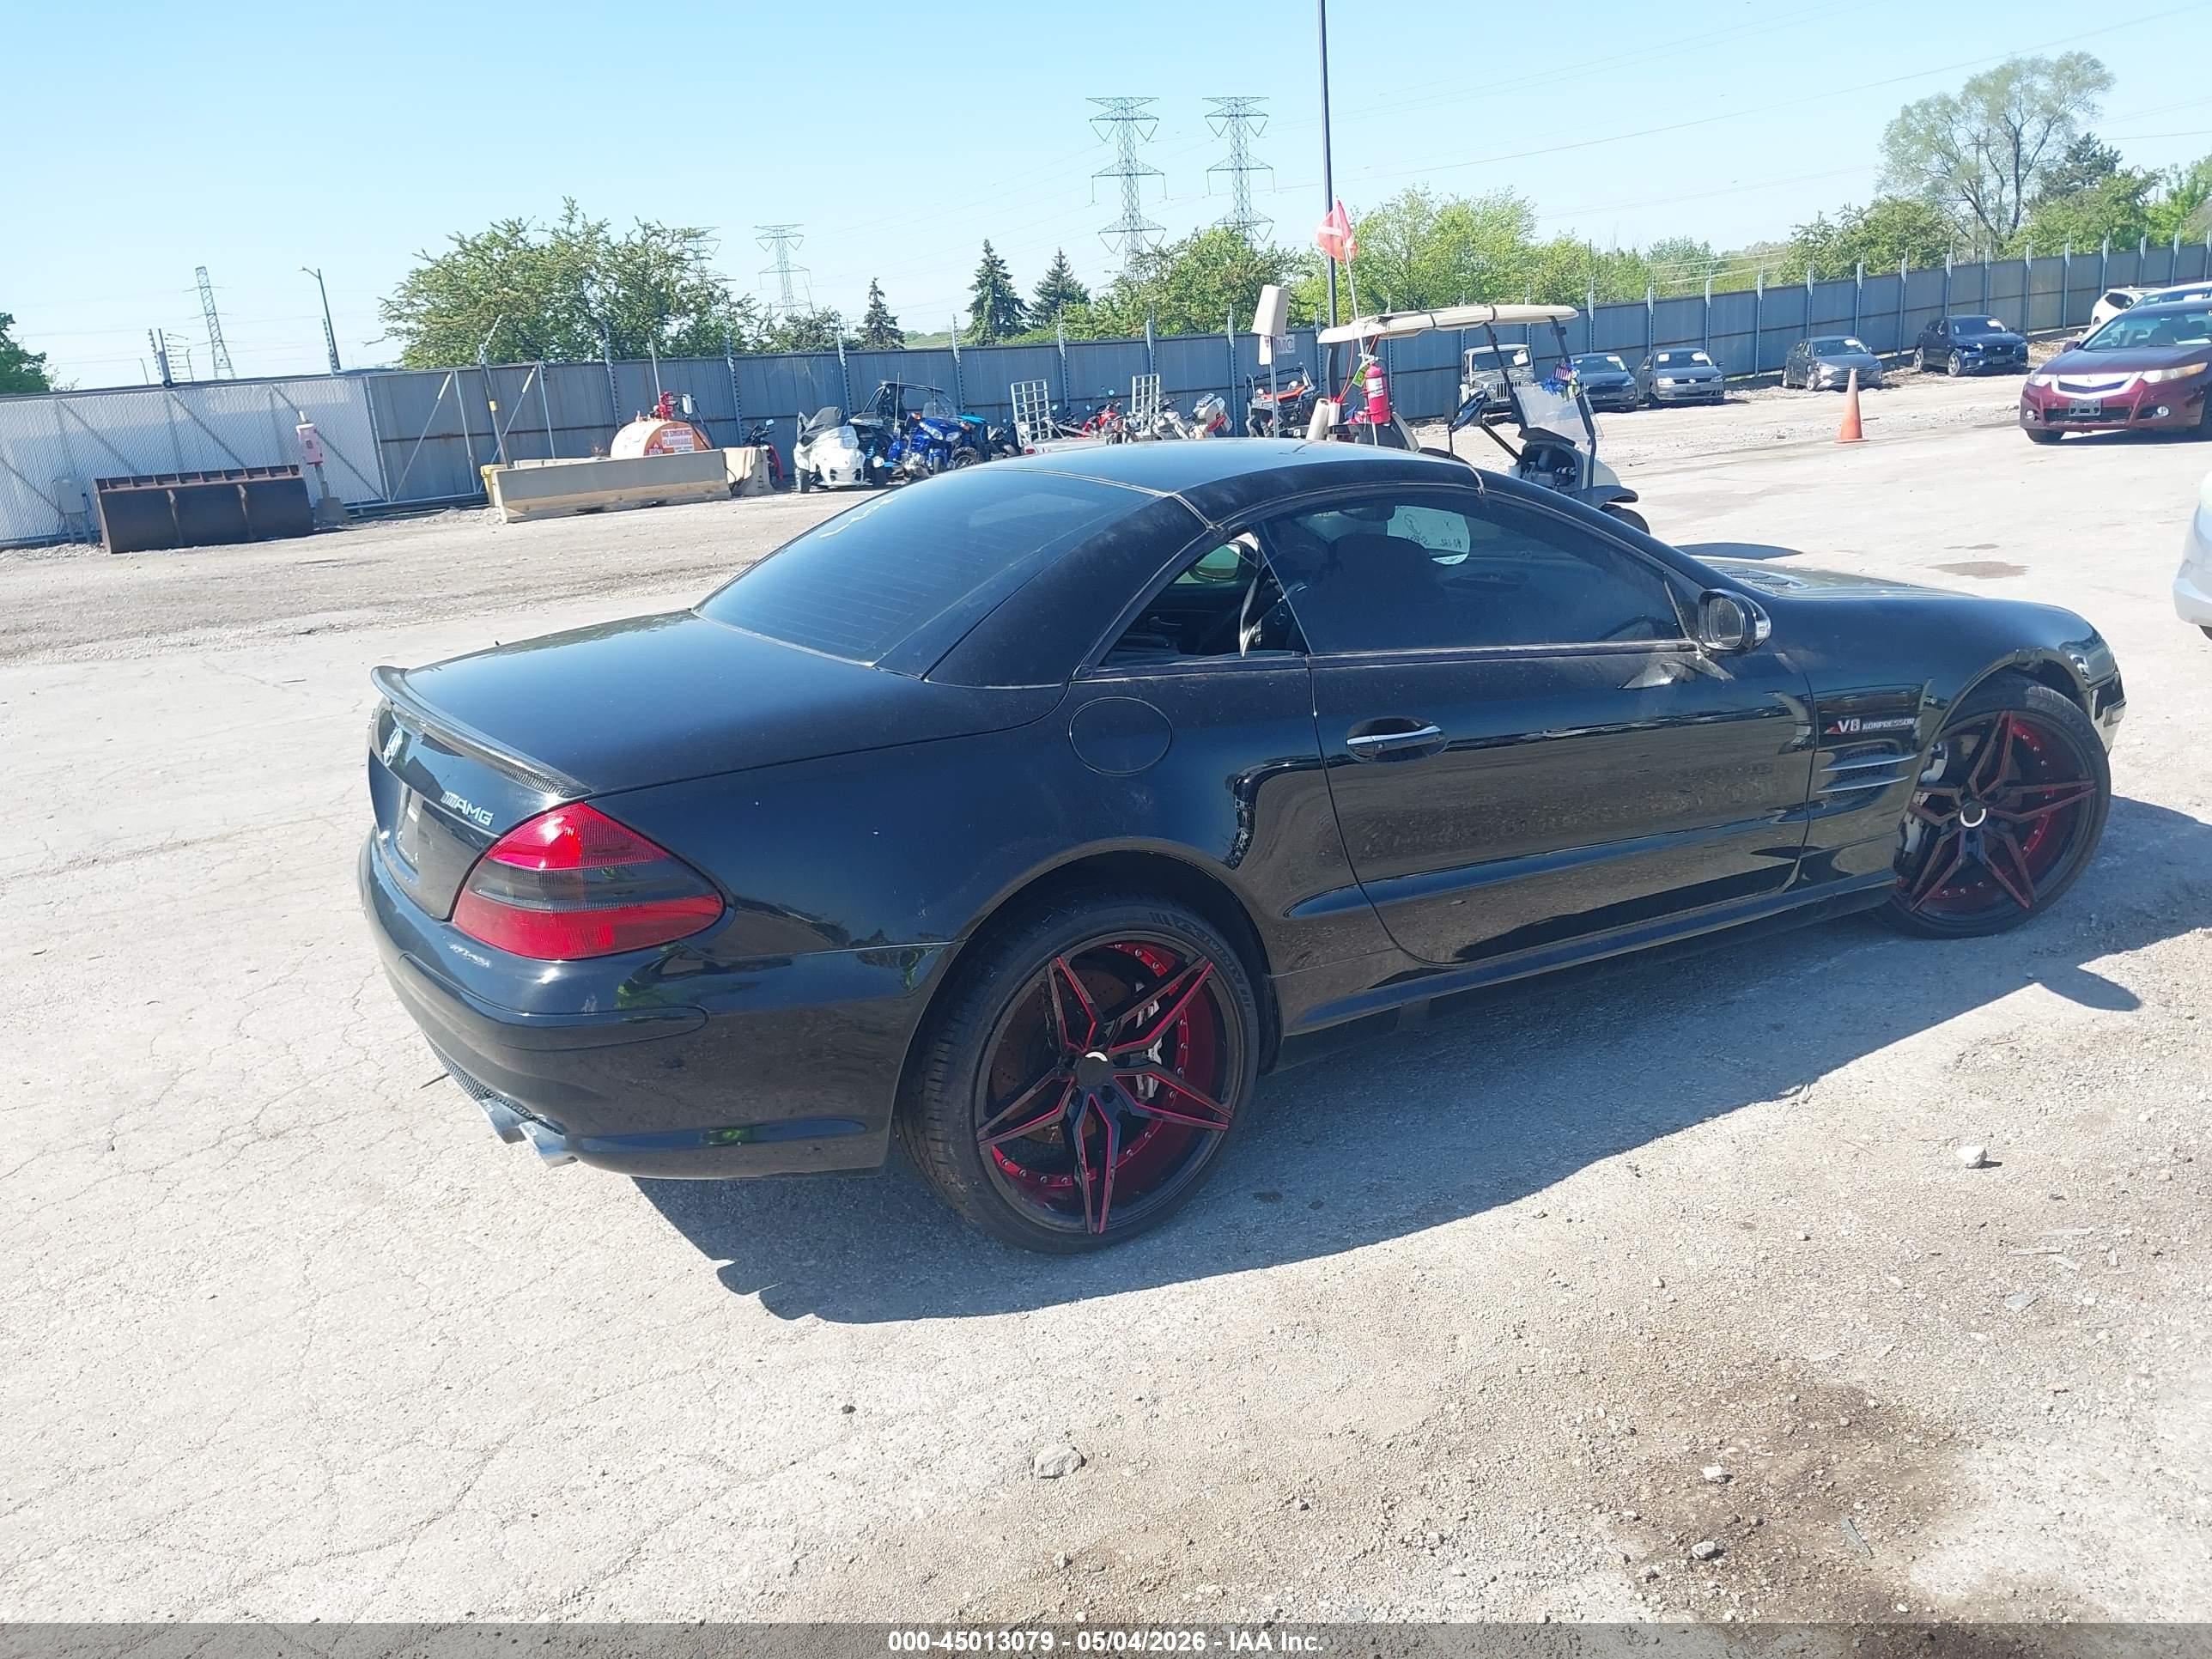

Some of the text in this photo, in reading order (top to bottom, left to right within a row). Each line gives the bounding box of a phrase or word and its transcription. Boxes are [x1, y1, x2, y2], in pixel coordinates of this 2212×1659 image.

[1838, 718, 1916, 733] V8 KOMPRESSOR
[454, 798, 495, 826] AMG
